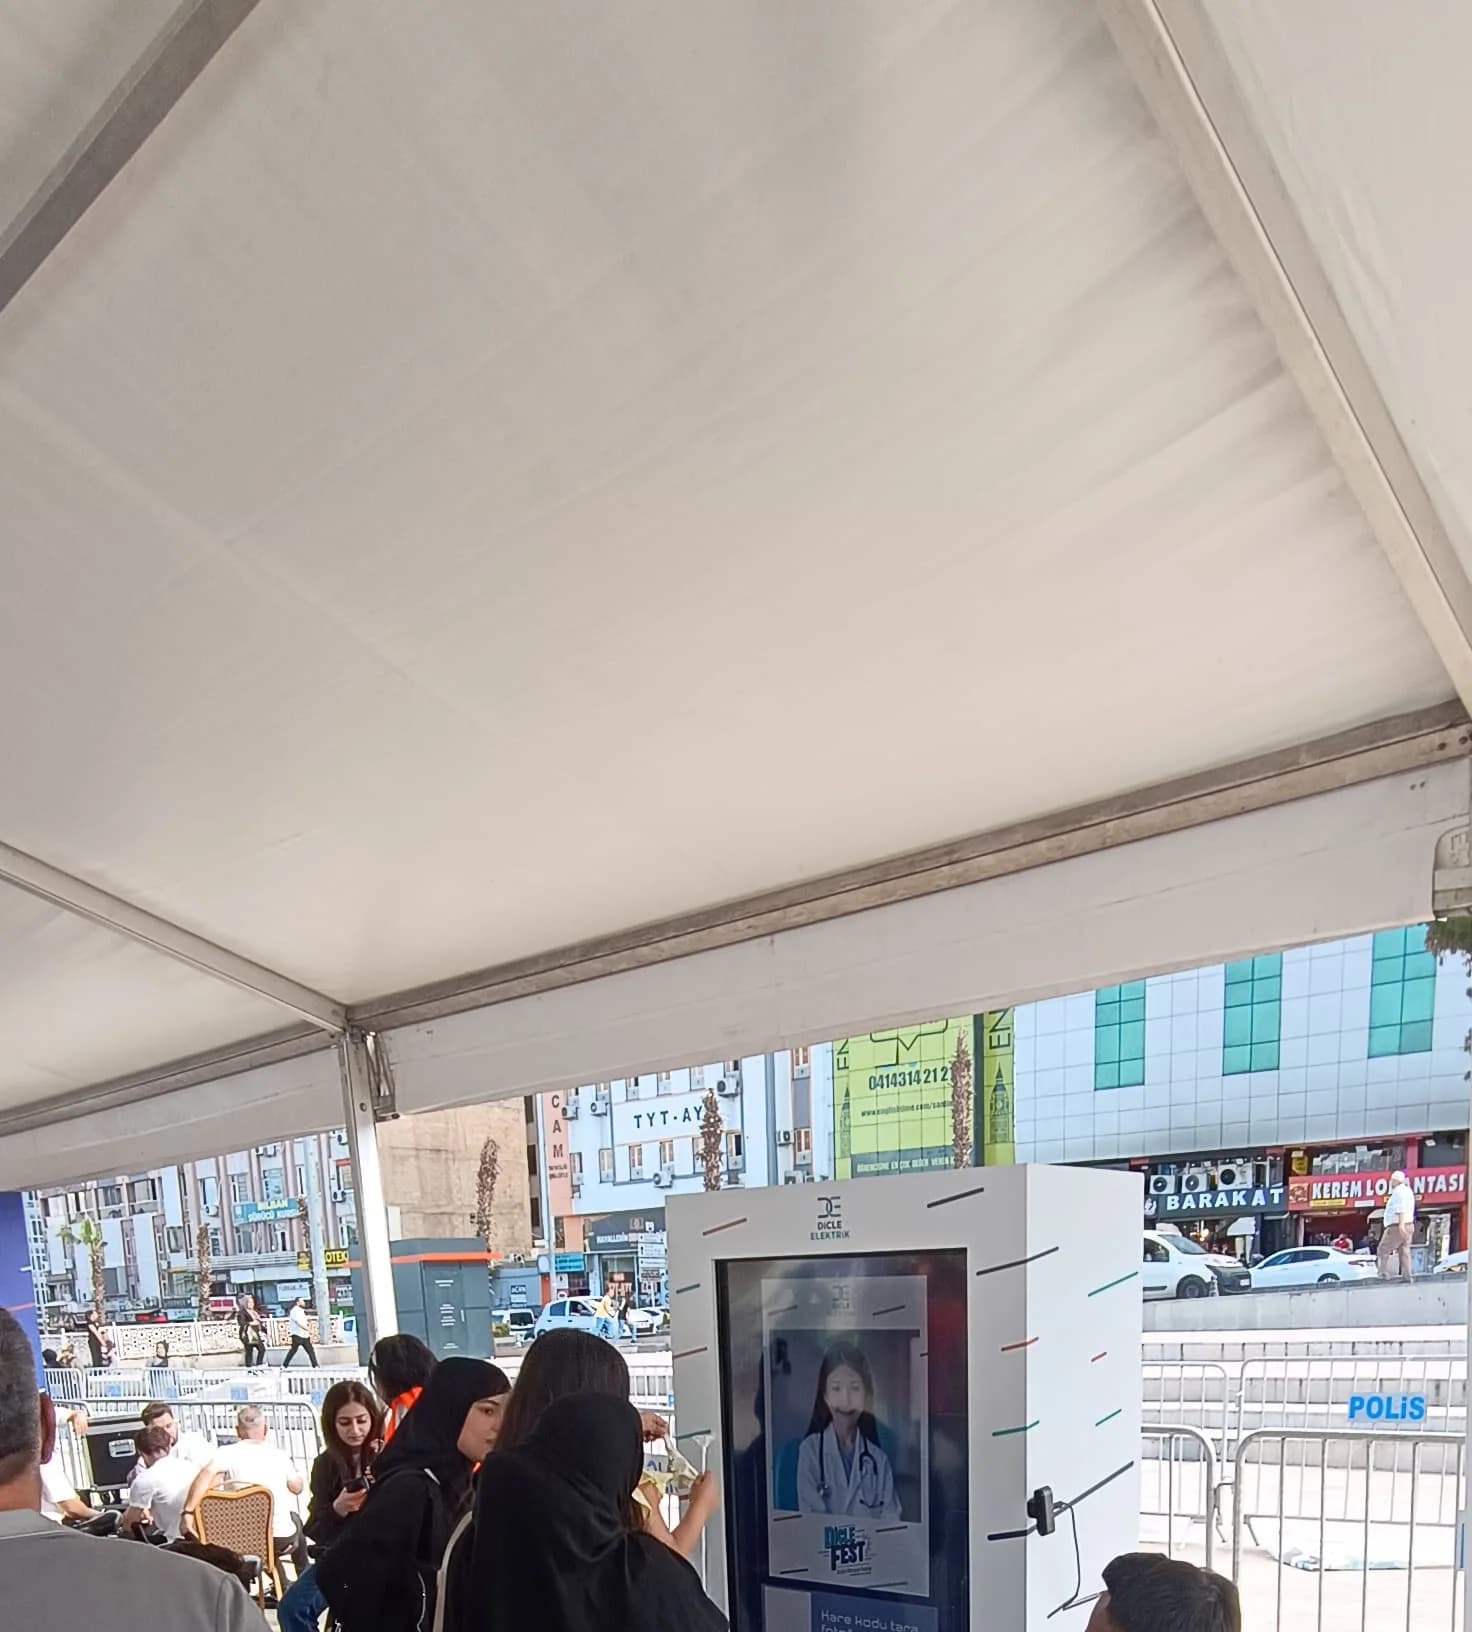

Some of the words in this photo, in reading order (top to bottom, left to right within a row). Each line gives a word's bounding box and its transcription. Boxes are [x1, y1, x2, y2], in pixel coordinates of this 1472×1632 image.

[1166, 1188, 1284, 1211] BARAKAT
[1311, 1181, 1363, 1200] KEREM
[1366, 1172, 1465, 1197] LONTASI
[831, 1540, 866, 1571] FEST
